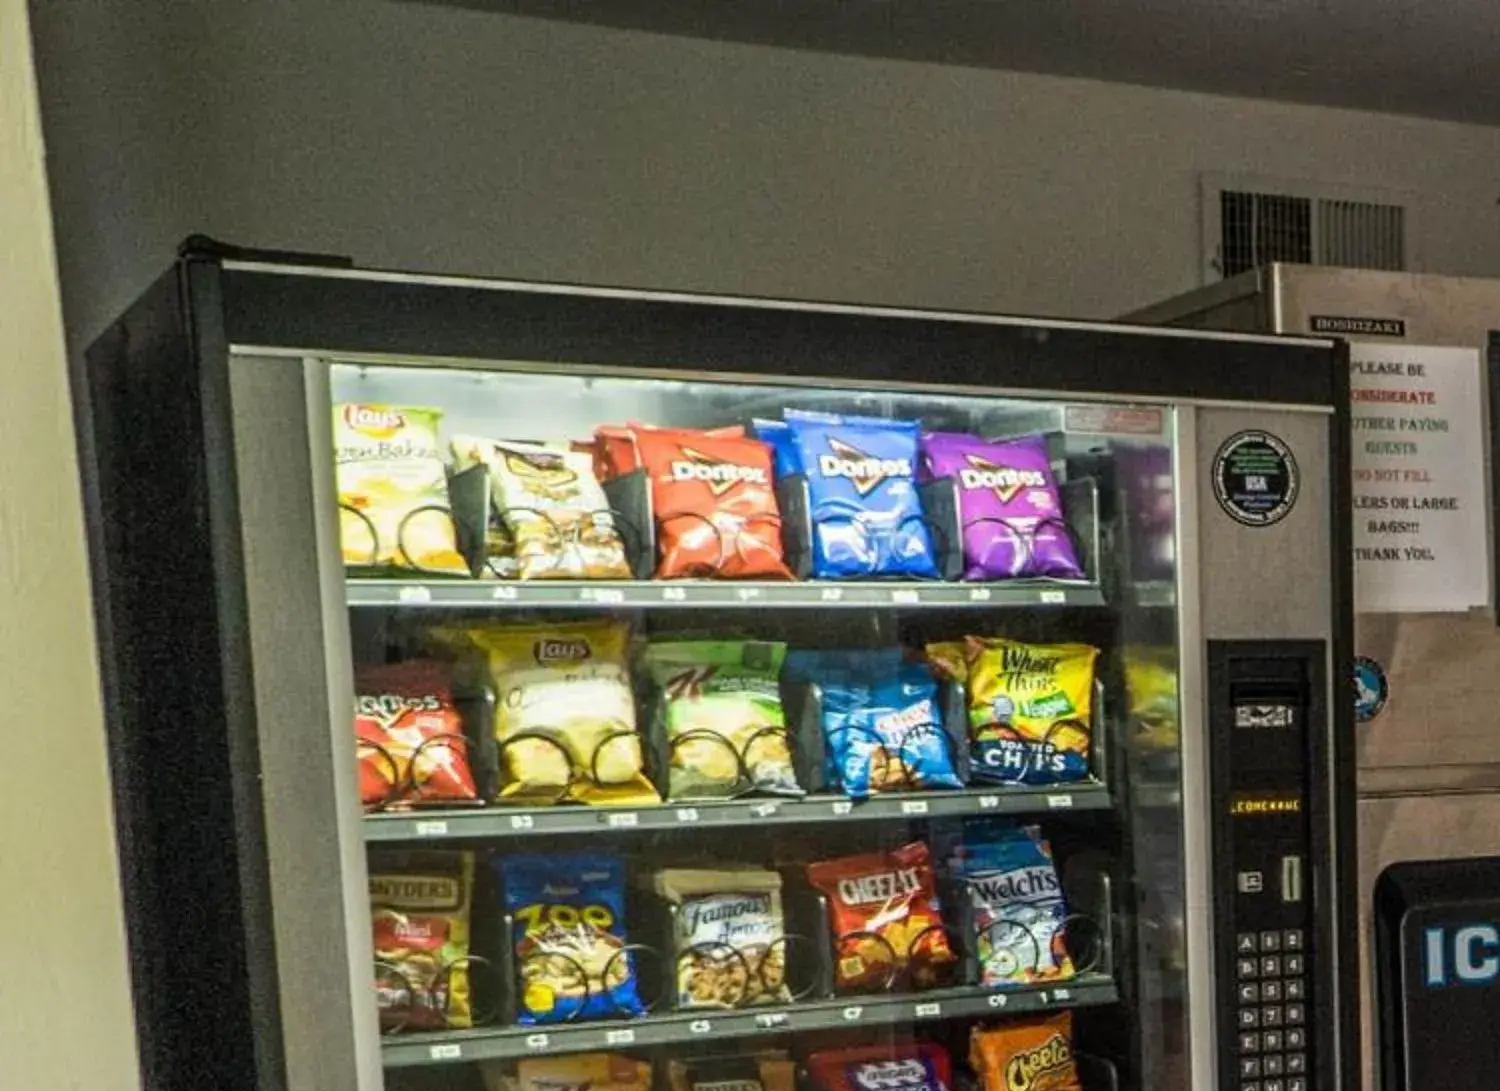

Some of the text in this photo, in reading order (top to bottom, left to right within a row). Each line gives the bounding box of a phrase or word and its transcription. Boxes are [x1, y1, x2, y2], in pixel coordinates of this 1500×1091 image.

[1315, 319, 1400, 334] HOSHIZAKI
[1351, 361, 1425, 377] PLEASE BE
[1351, 388, 1436, 405] ONSIDERATE
[1399, 418, 1448, 432] PAYING
[1365, 440, 1418, 454] GUESTS
[671, 460, 768, 483] Doritos
[817, 454, 912, 478] Doritos
[1375, 469, 1400, 481] NOT
[1404, 470, 1432, 482] FILL
[960, 468, 1046, 489] Doritos
[1391, 498, 1409, 509] OR
[1413, 498, 1458, 510] LARGE
[1355, 547, 1400, 560] THANK
[1001, 645, 1060, 674] Wheat
[995, 671, 1058, 693] Thins
[355, 694, 441, 715] oritos
[985, 748, 1067, 771] CHPS
[972, 866, 1060, 902] Welch's
[516, 903, 615, 934] ZOO
